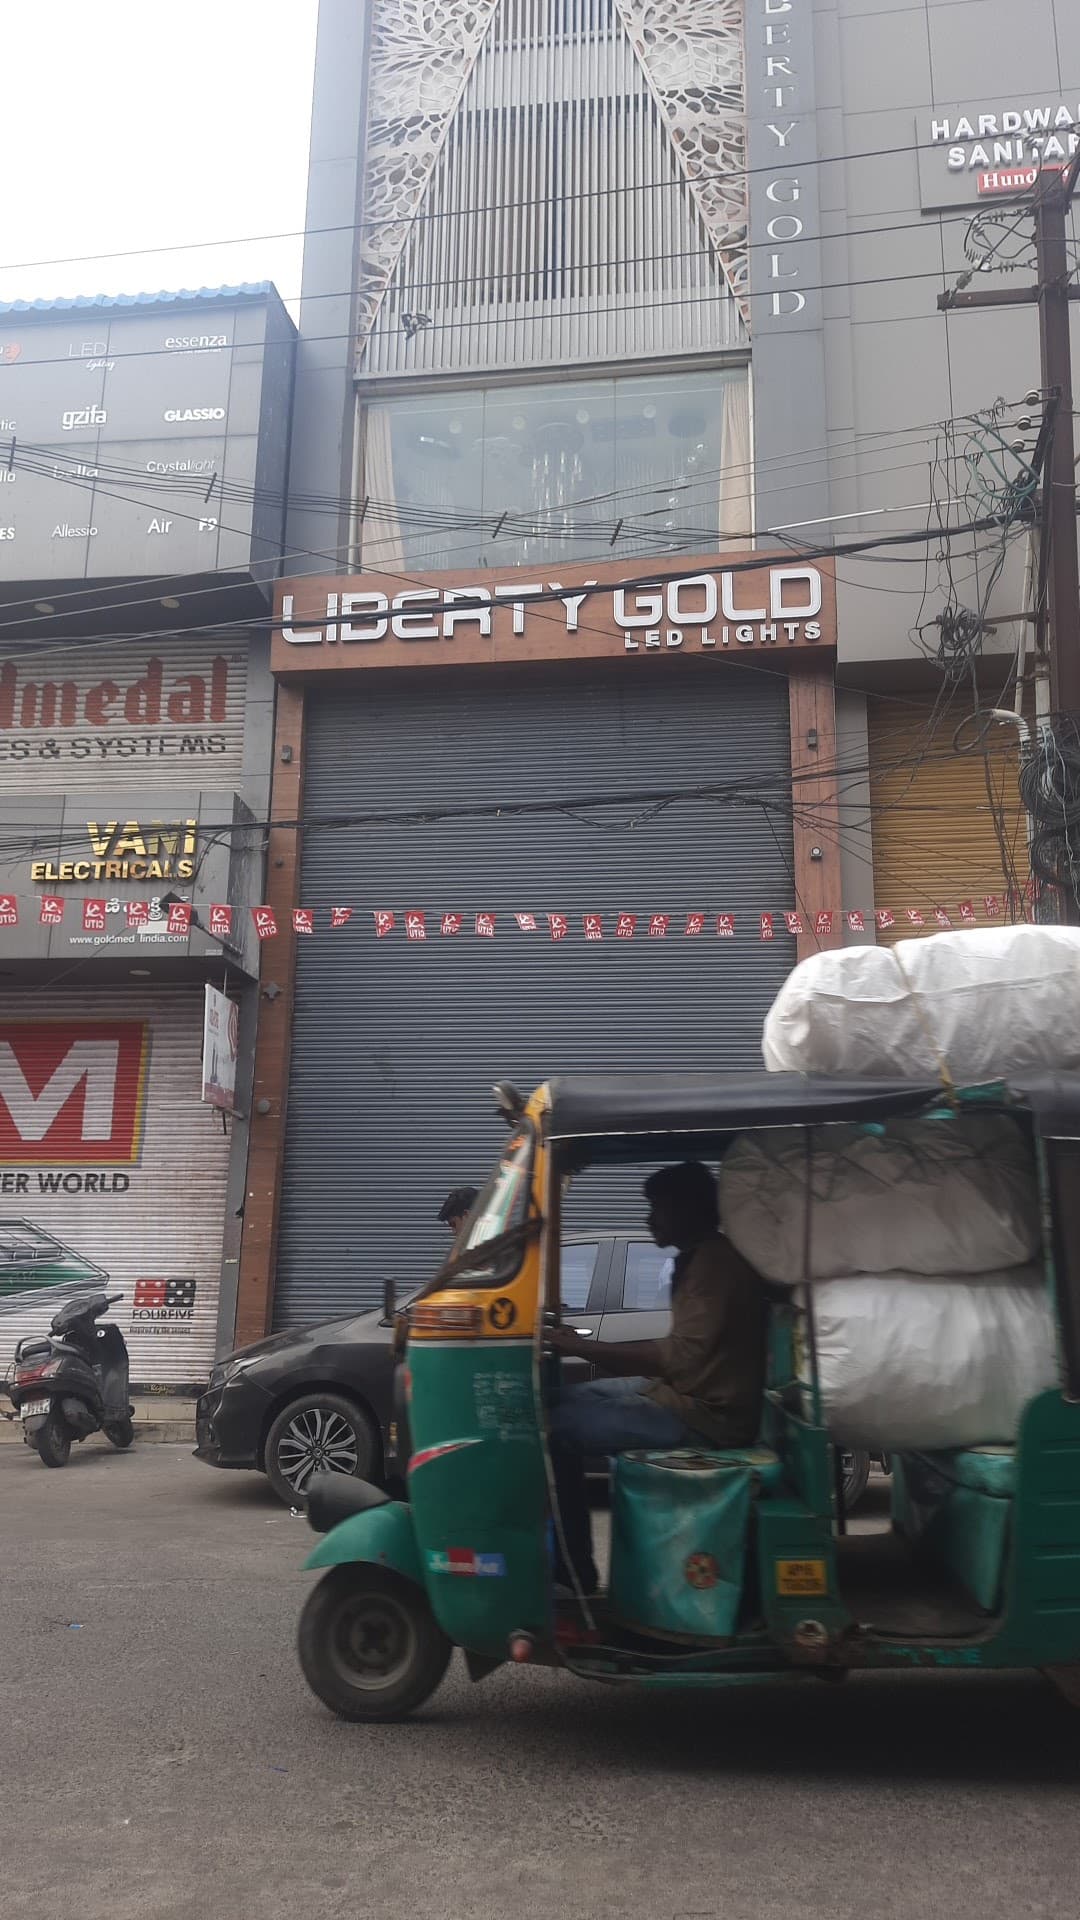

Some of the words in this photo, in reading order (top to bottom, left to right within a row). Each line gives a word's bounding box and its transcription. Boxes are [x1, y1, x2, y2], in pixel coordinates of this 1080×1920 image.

[931, 104, 1080, 141] HARDWA
[766, 178, 806, 316] GOLD
[165, 335, 227, 349] essenza
[62, 405, 107, 430] gzifa
[164, 407, 225, 422] GLASSIO
[52, 523, 98, 538] Allessio
[147, 518, 173, 534] Air
[282, 580, 598, 643] LIBERTY
[613, 567, 822, 628] GOLD
[624, 628, 684, 649] LED
[701, 620, 822, 646] LIGHTS
[86, 818, 197, 856] VANI
[31, 858, 194, 881] ELECTRICALS
[0, 1173, 30, 1194] ER
[38, 1172, 131, 1194] WORLD
[132, 1309, 195, 1320] FOURFIVE
